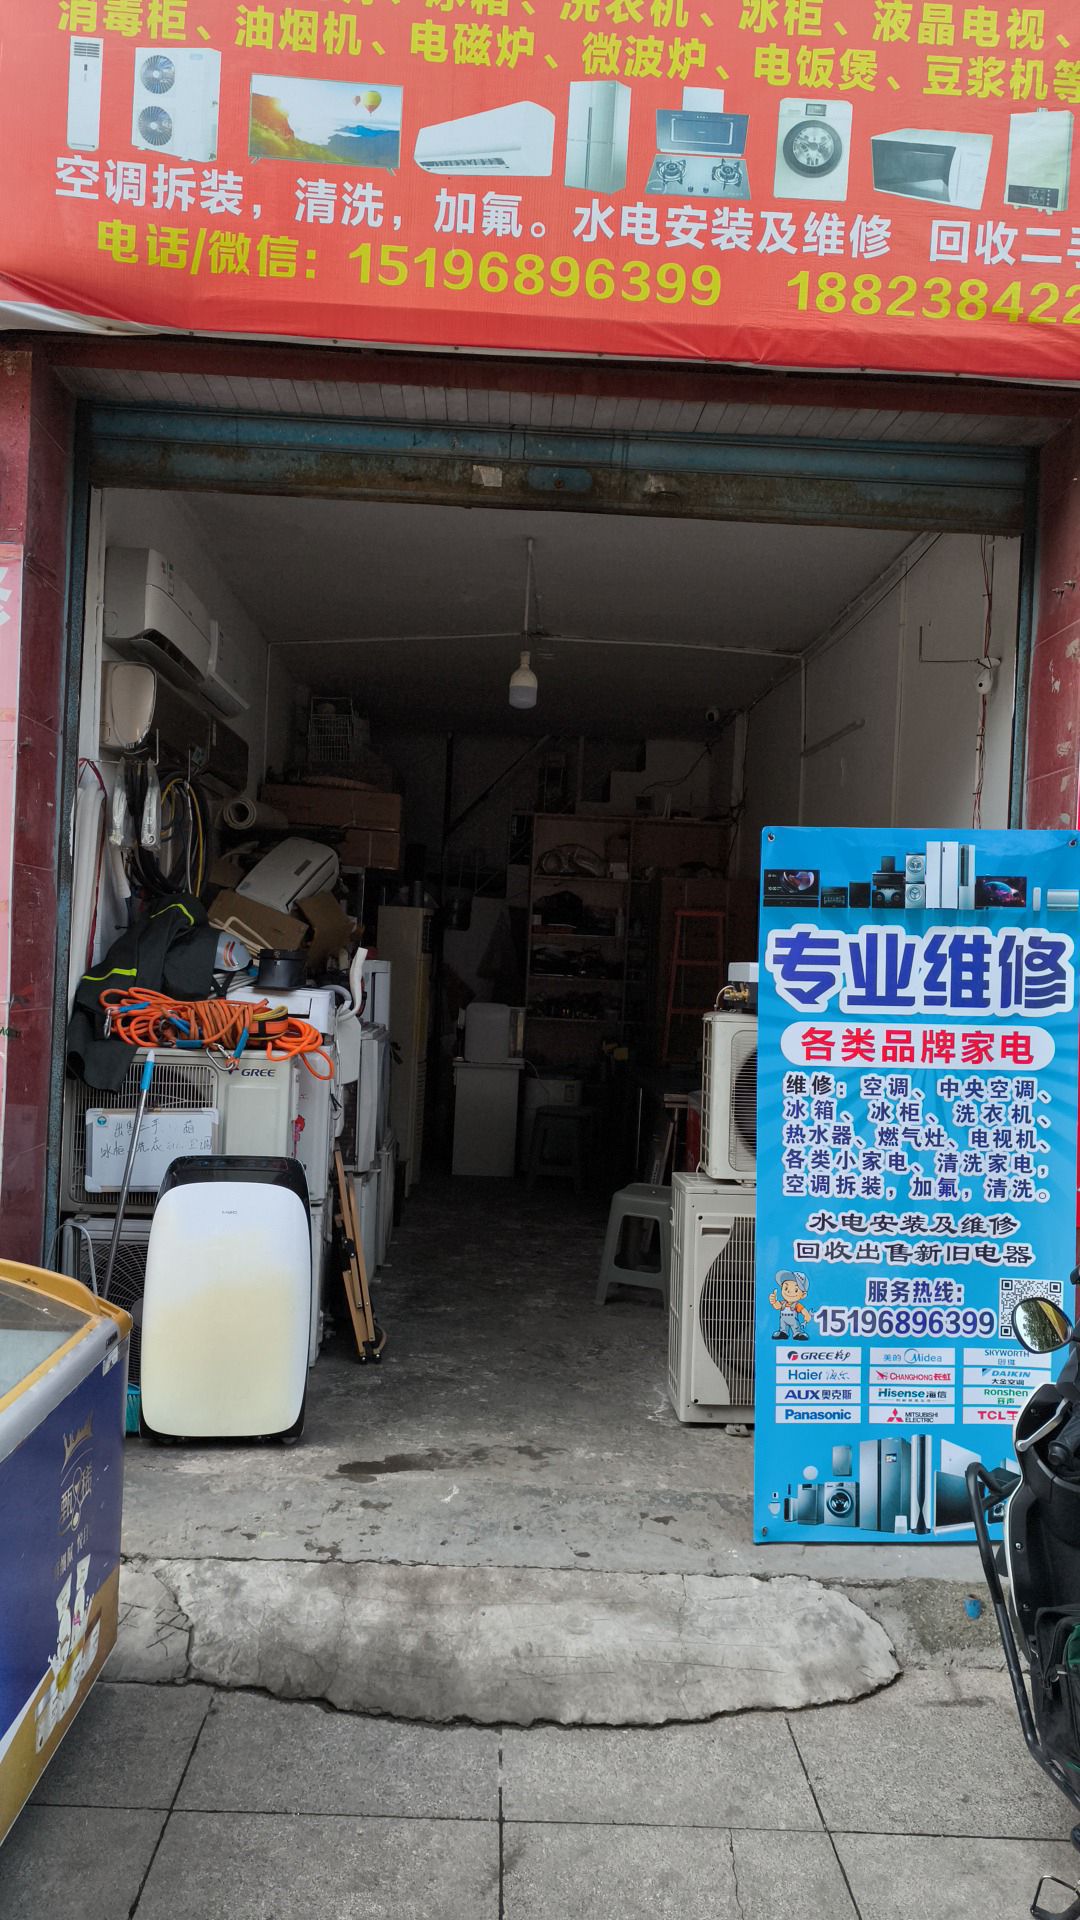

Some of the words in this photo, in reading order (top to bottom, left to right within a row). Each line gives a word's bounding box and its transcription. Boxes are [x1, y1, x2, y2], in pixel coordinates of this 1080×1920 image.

[349, 243, 721, 307] 15196896399
[772, 931, 1067, 1009] 专业维修
[801, 1027, 1034, 1064] 各类品牌家电
[241, 1068, 277, 1077] GREE
[808, 1212, 1018, 1236] 水电安装及维修
[796, 1242, 1033, 1264] 回收出售新旧电器
[817, 1308, 995, 1335] 15196896399
[911, 1351, 943, 1362] Midea
[984, 1349, 1030, 1358] SKYWORTH
[788, 1369, 823, 1380] Haier
[991, 1370, 1031, 1378] DAIKIN
[984, 1388, 1029, 1397] Ronshen
[784, 1408, 852, 1420] Panasonic
[904, 1411, 939, 1419] MITSUBISHI
